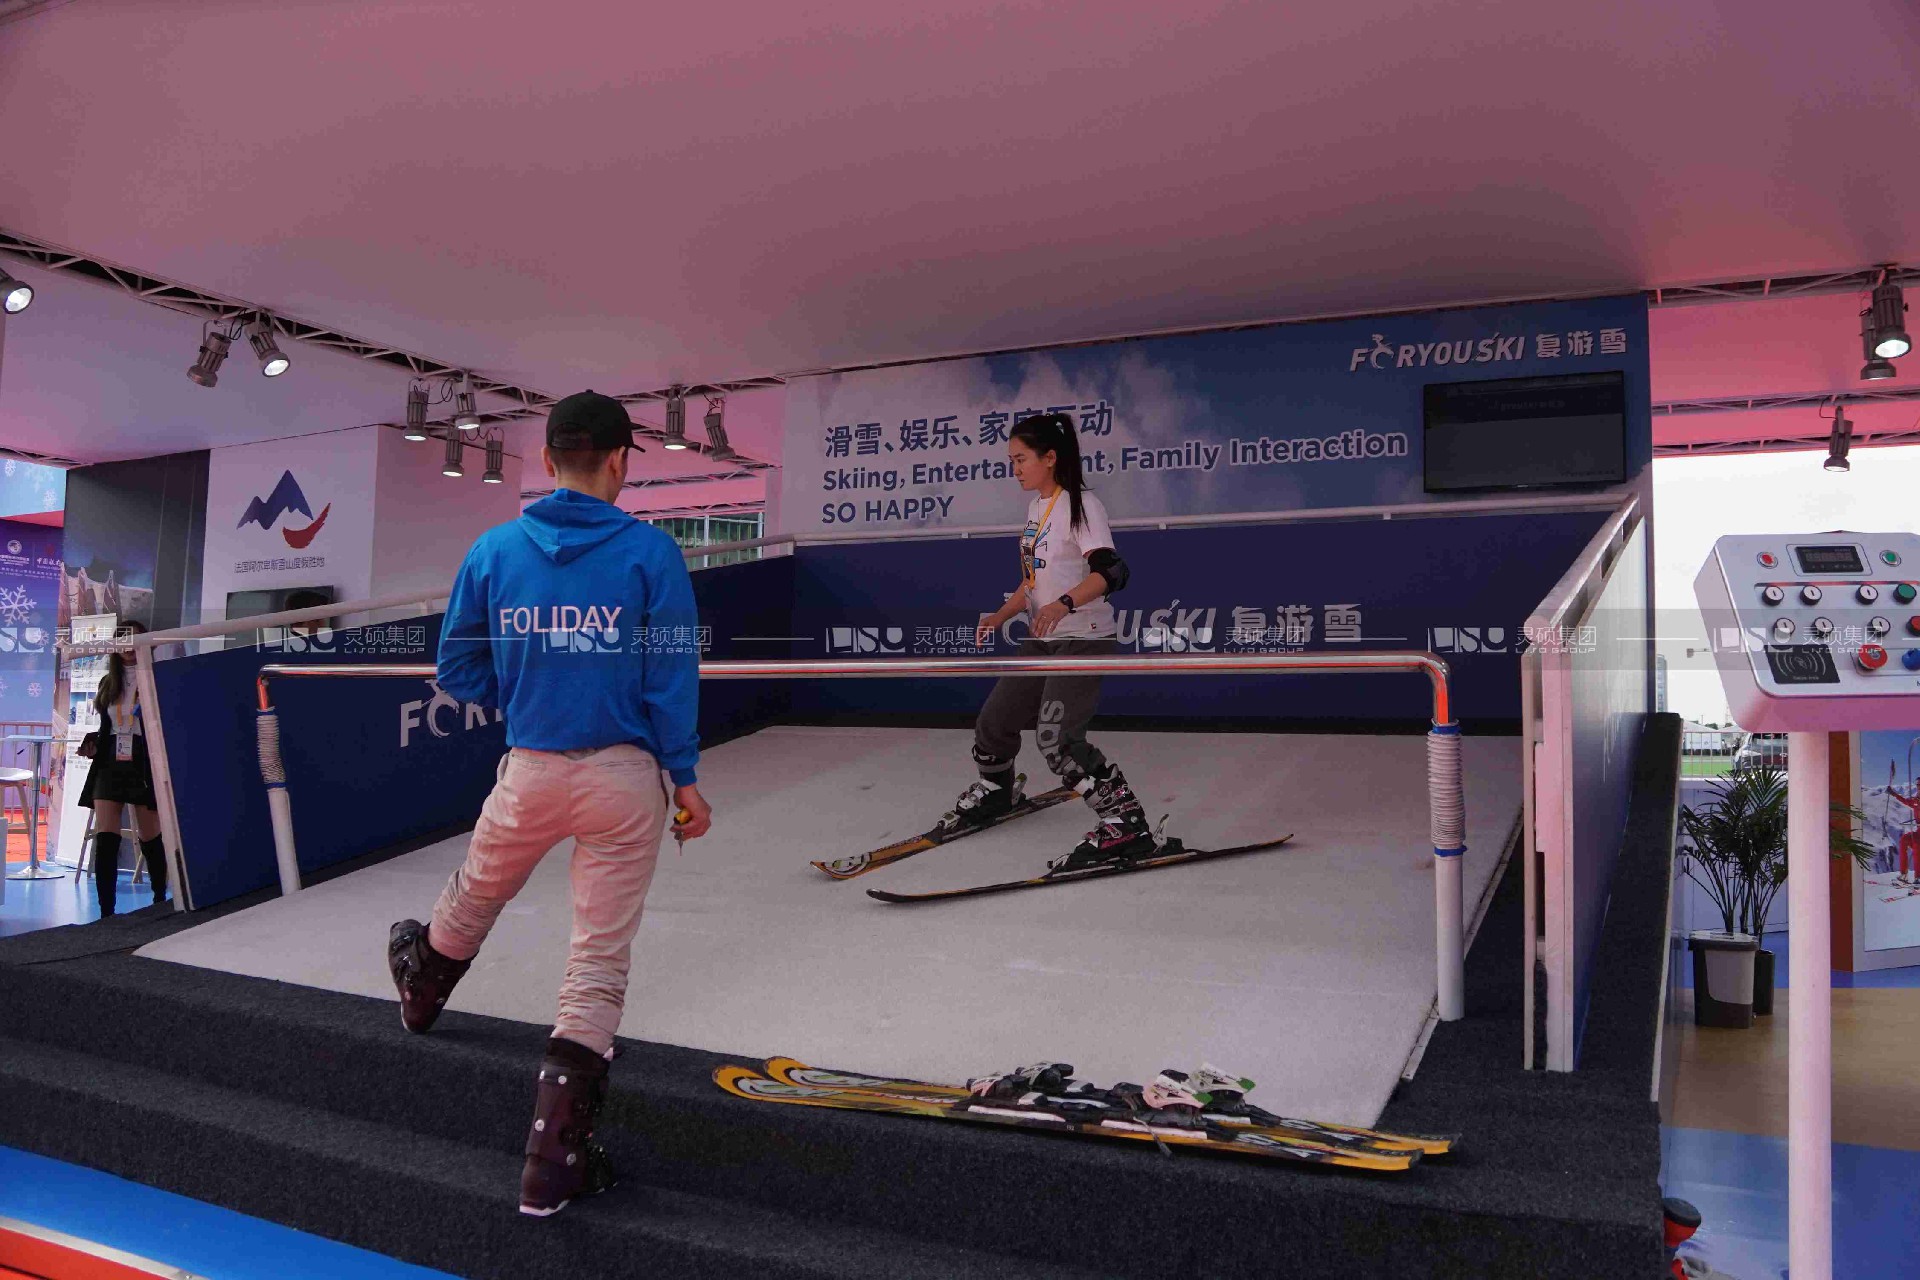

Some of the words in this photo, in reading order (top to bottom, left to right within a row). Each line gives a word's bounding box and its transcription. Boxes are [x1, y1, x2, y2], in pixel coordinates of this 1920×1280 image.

[824, 401, 1112, 458] 滑雪、娱乐、家动
[823, 468, 907, 491] Skiing,
[1120, 441, 1219, 472] Family
[1231, 430, 1406, 462] Interaction
[822, 503, 856, 524] SO
[865, 496, 955, 521] HAPPY
[500, 606, 622, 634] FOLIDAY
